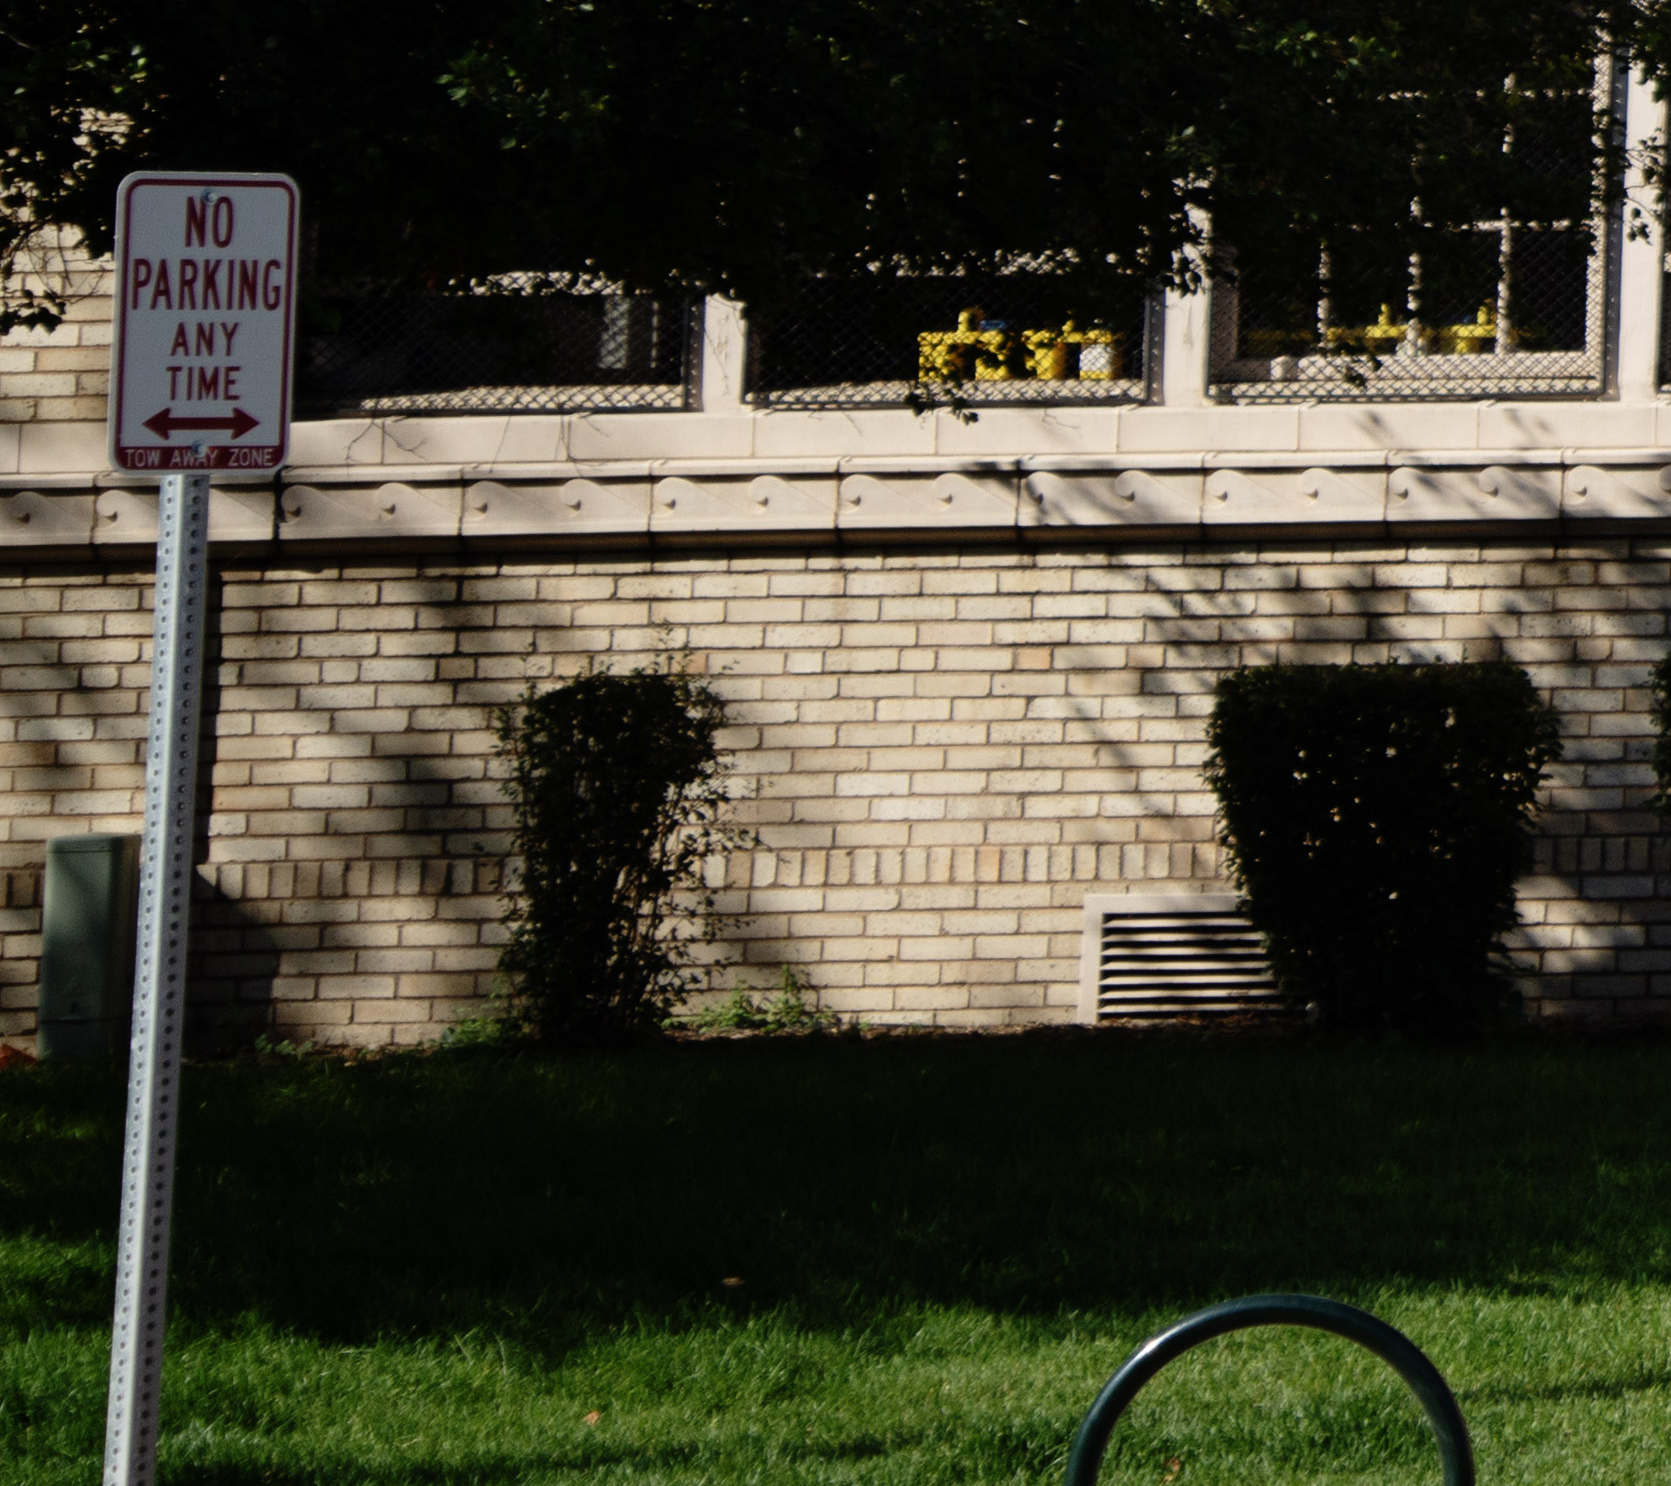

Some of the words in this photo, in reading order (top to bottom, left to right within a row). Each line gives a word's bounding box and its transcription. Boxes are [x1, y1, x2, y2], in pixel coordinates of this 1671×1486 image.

[184, 195, 234, 248] NO
[131, 258, 282, 311] PARKING
[170, 321, 241, 358] ANY
[166, 365, 241, 402] TIME
[125, 450, 161, 468] TOW
[169, 449, 217, 468] AWAY
[228, 447, 274, 467] ZONE
